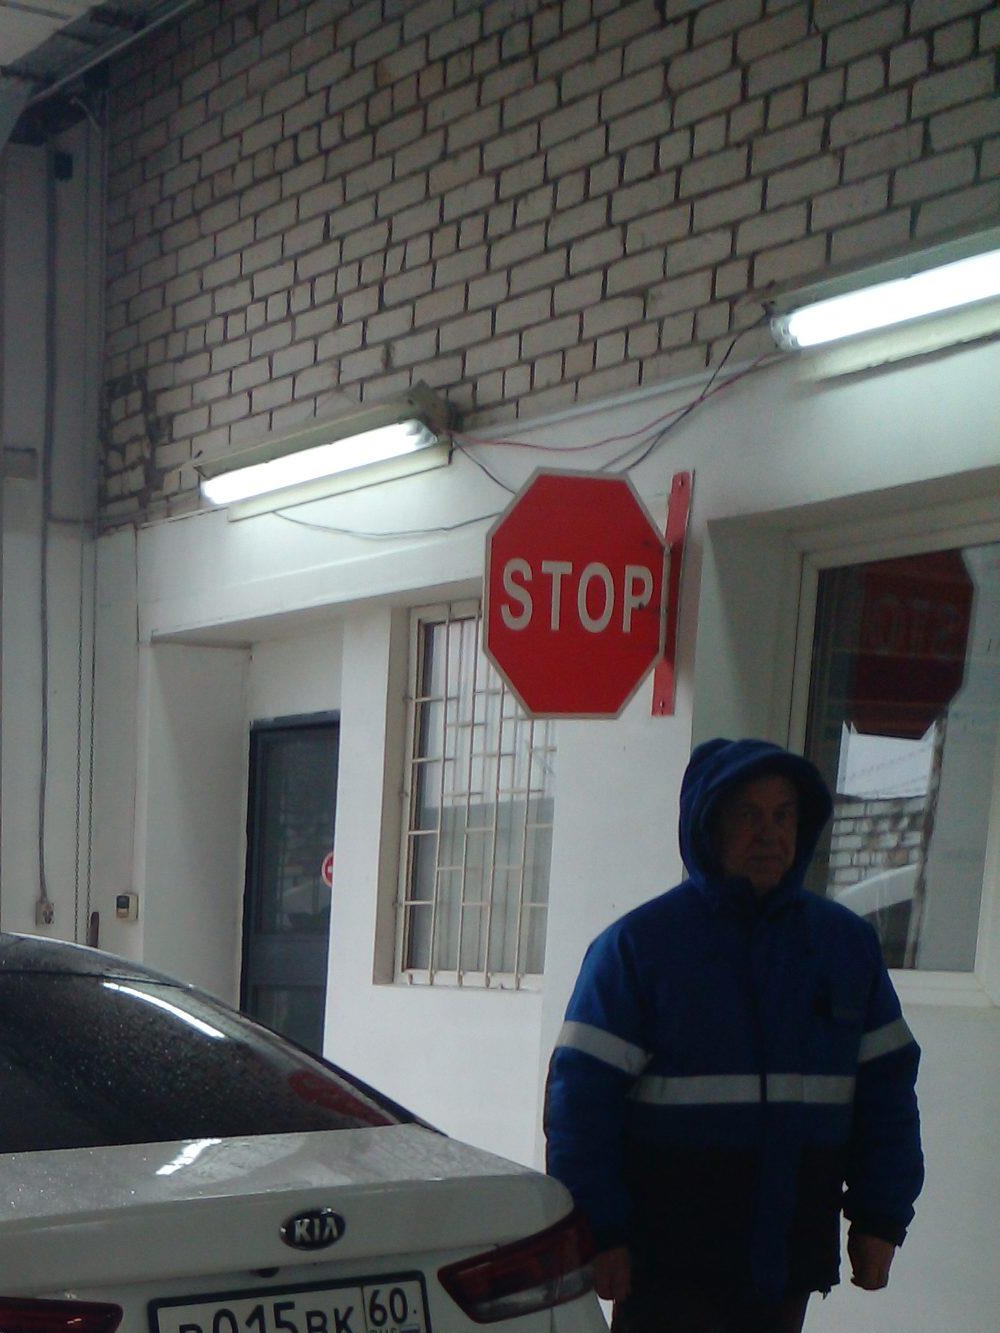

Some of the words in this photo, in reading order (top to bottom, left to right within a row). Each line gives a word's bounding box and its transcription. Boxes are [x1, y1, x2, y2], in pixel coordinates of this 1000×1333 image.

[501, 557, 653, 633] STOP
[294, 1216, 338, 1243] KIA
[369, 1287, 408, 1327] 60
